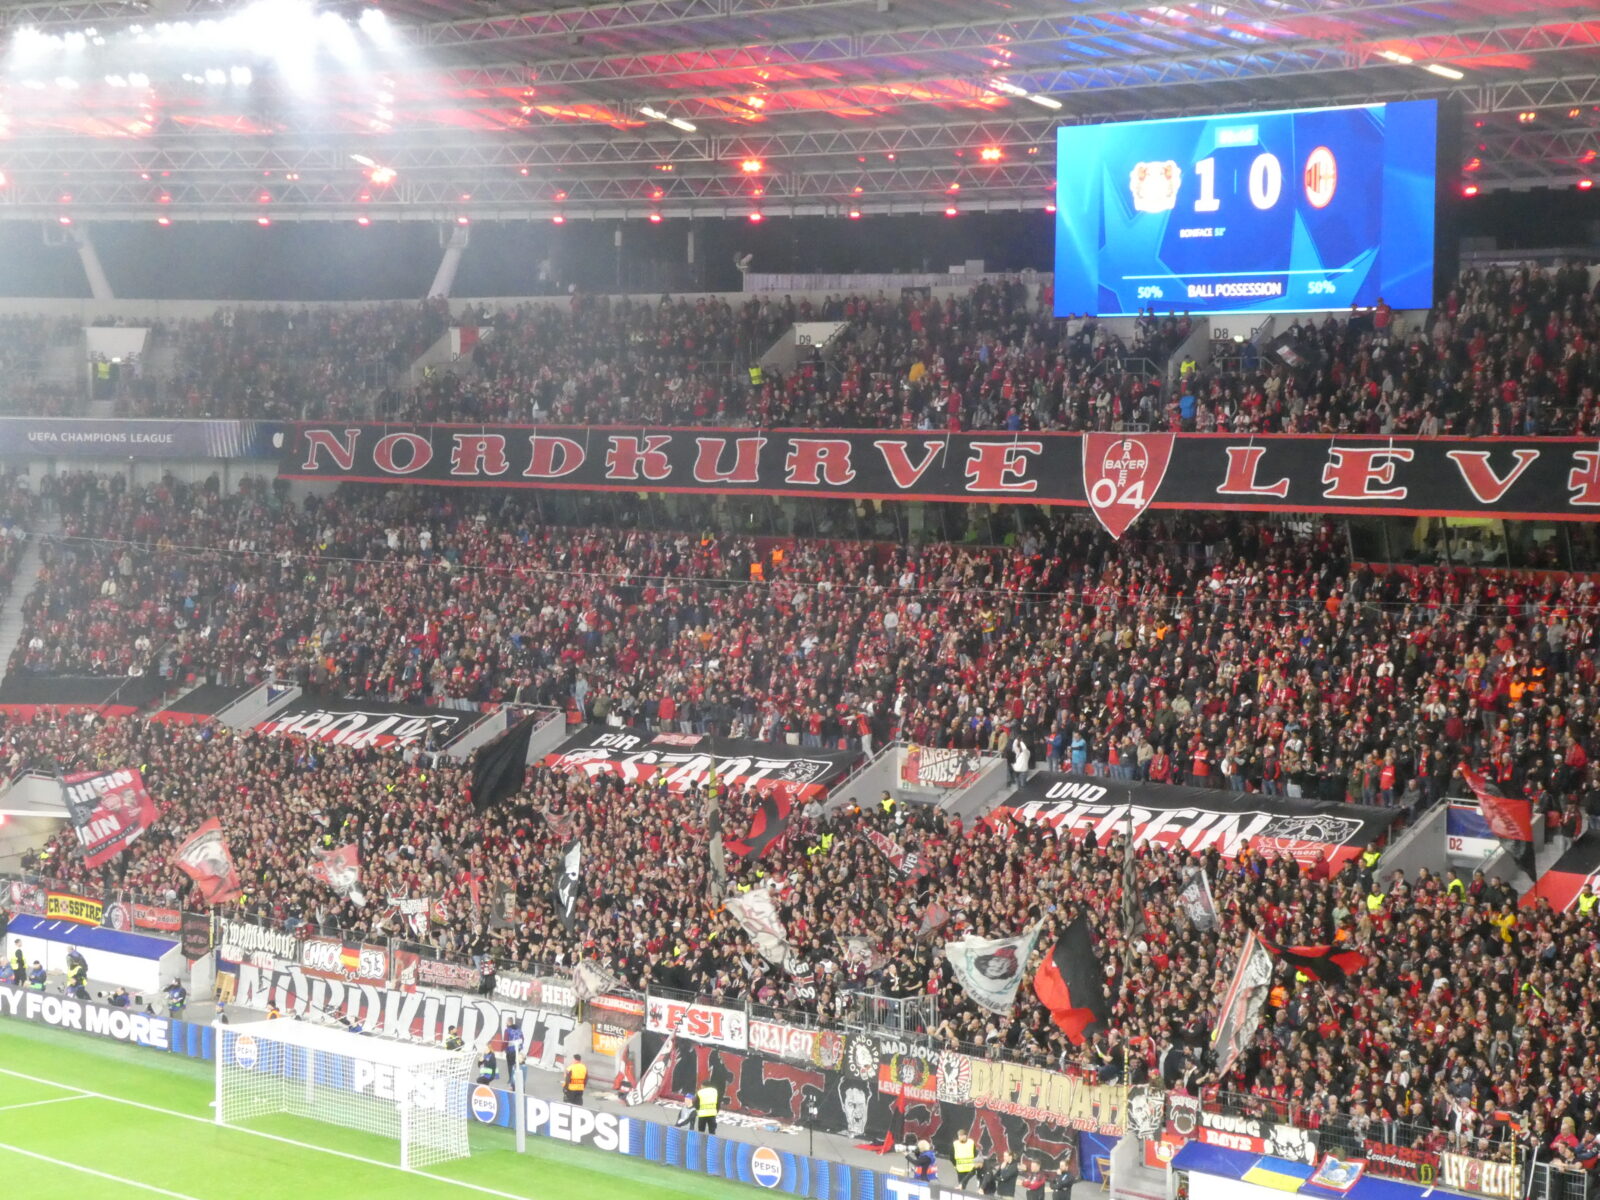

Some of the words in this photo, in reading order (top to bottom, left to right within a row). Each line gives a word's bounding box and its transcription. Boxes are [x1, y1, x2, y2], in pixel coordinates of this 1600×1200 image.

[1194, 157, 1220, 212] 1
[1249, 152, 1282, 210] 0
[1180, 228, 1213, 238] BONIFACE
[1138, 285, 1163, 299] 50%
[1187, 284, 1214, 298] BALL
[1216, 282, 1282, 297] POSSESSION
[1308, 280, 1336, 294] 50%
[1213, 328, 1229, 339] D8
[28, 431, 57, 442] UEFA
[60, 432, 127, 443] CHAMPIONS
[130, 432, 174, 443] LEAGUE
[302, 429, 1042, 492] NORDKURVE
[1105, 459, 1146, 470] BAYER
[1091, 478, 1146, 509] 04
[590, 733, 641, 750] FÜR
[1045, 782, 1107, 803] UND
[1449, 838, 1463, 851] D2
[26, 993, 82, 1030] FOR
[85, 1005, 169, 1049] MORE
[880, 1040, 908, 1056] MAD
[474, 1098, 495, 1110] PEPSI
[527, 1096, 630, 1154] PEPSI
[754, 1160, 781, 1175] PEPSI
